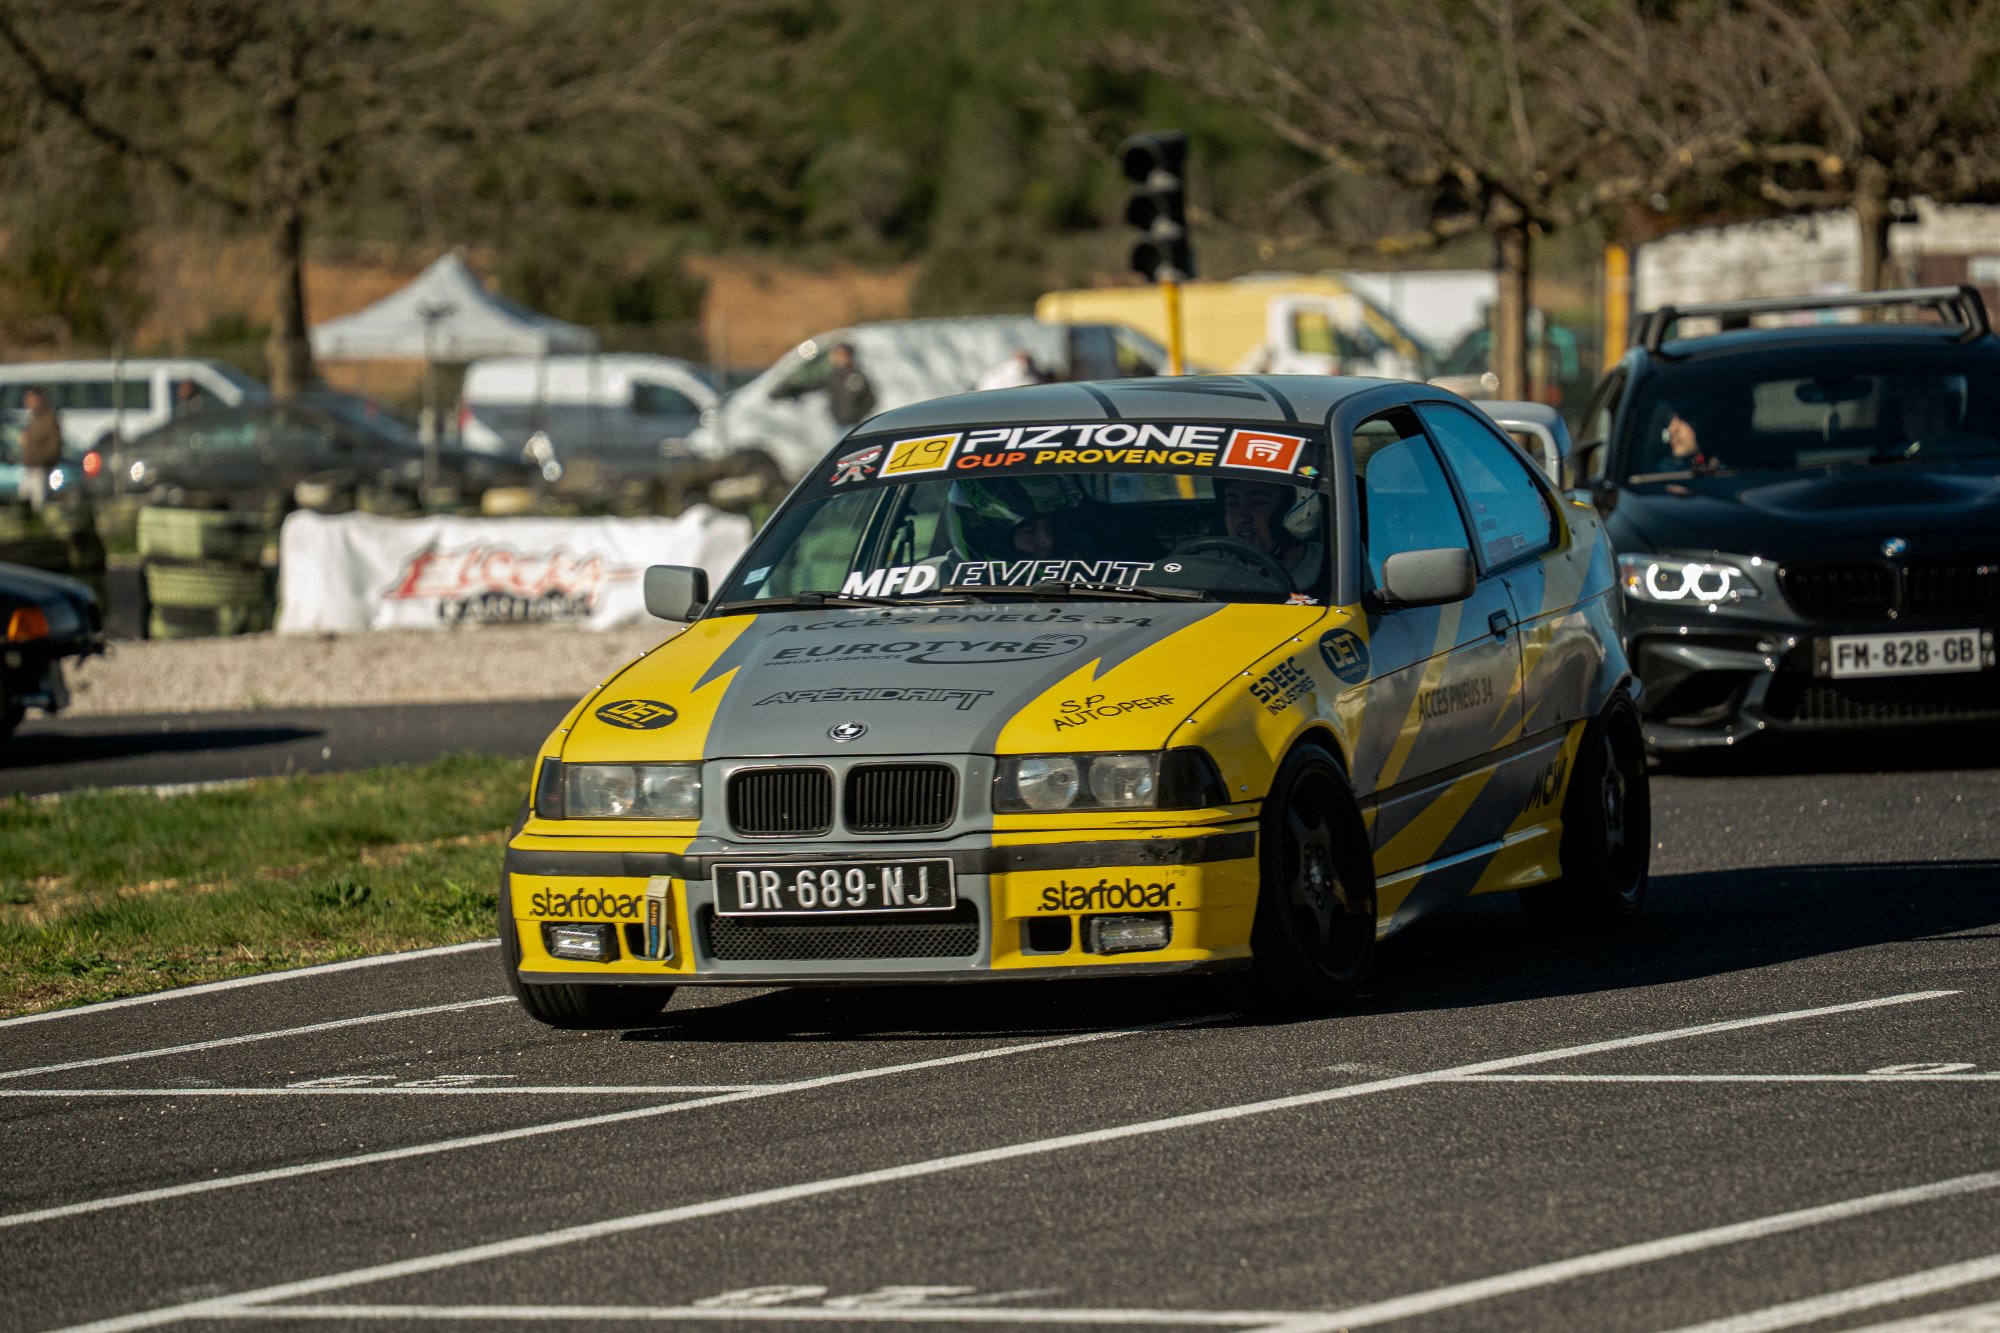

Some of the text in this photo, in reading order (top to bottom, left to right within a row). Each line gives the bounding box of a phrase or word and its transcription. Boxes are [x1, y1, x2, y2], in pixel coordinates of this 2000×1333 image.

[962, 424, 1226, 453] PIZTONE
[889, 440, 949, 470] 19
[956, 449, 1217, 469] CUP PROVENCE
[838, 560, 1155, 599] MFD EVENT
[926, 614, 1086, 623] PNEUS
[1093, 616, 1153, 627] 34
[771, 641, 1058, 660] EUROTYRE
[1837, 637, 1975, 669] FM-828-GB
[1052, 694, 1176, 732] AUTOPERF
[736, 866, 929, 909] DR-689-NJ
